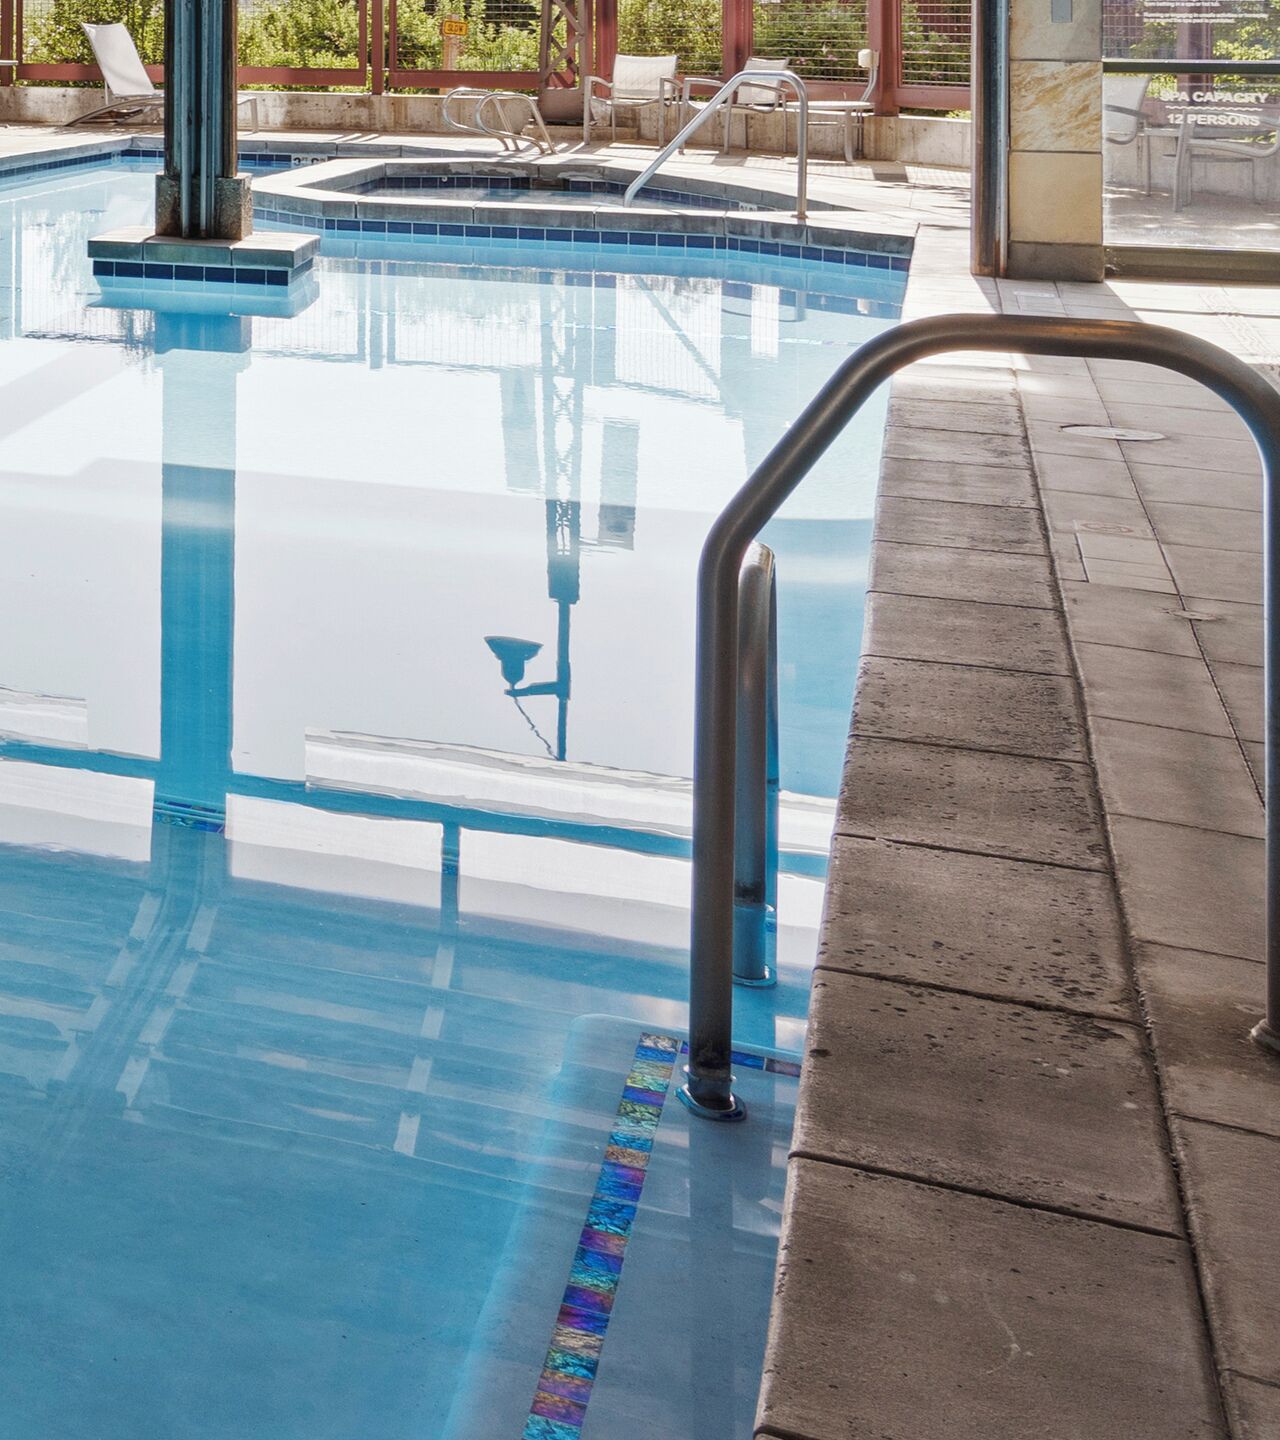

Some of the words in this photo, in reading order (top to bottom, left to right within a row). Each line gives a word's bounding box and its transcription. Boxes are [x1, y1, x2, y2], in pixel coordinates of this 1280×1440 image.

[1160, 90, 1190, 102] SPA
[1192, 91, 1269, 104] CAPACITY
[1167, 113, 1184, 125] 12
[1186, 114, 1261, 126] PERSONS
